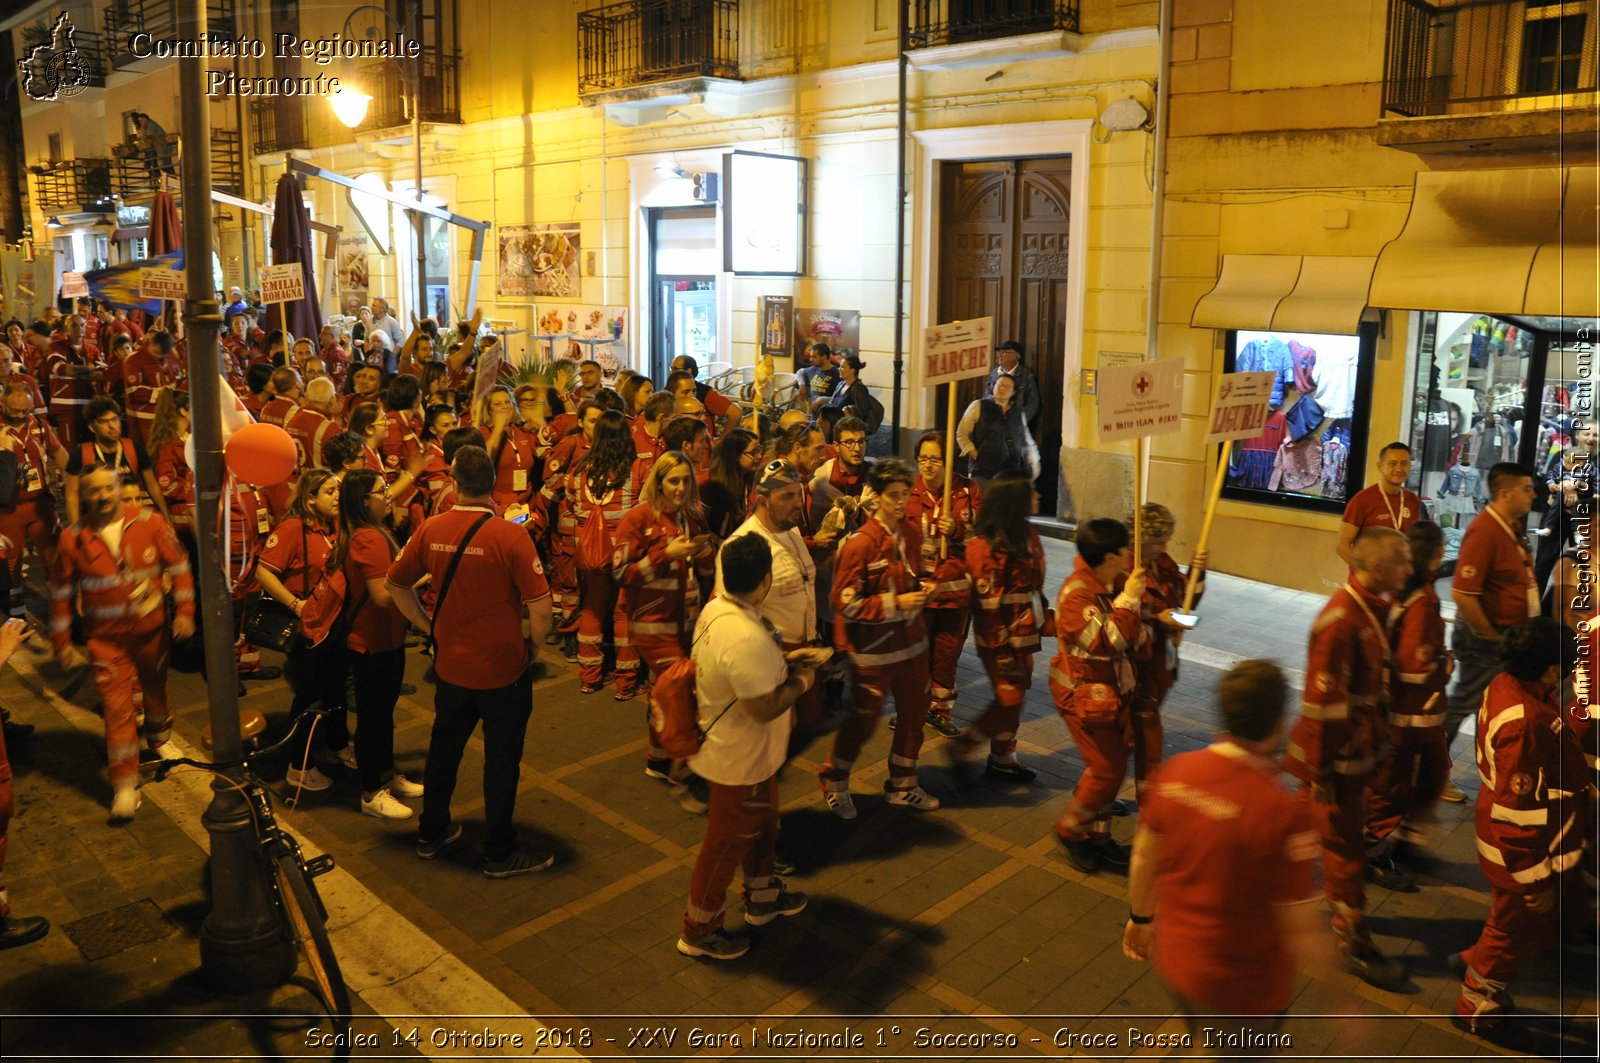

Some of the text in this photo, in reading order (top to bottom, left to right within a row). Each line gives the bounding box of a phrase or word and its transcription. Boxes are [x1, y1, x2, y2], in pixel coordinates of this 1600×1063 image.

[142, 280, 185, 291] FRIULI
[261, 278, 302, 292] EMILIA
[262, 288, 303, 303] ROMAGNA
[926, 345, 988, 378] MARCHE
[1210, 402, 1266, 434] LIGURIA
[431, 543, 444, 551] CROCE
